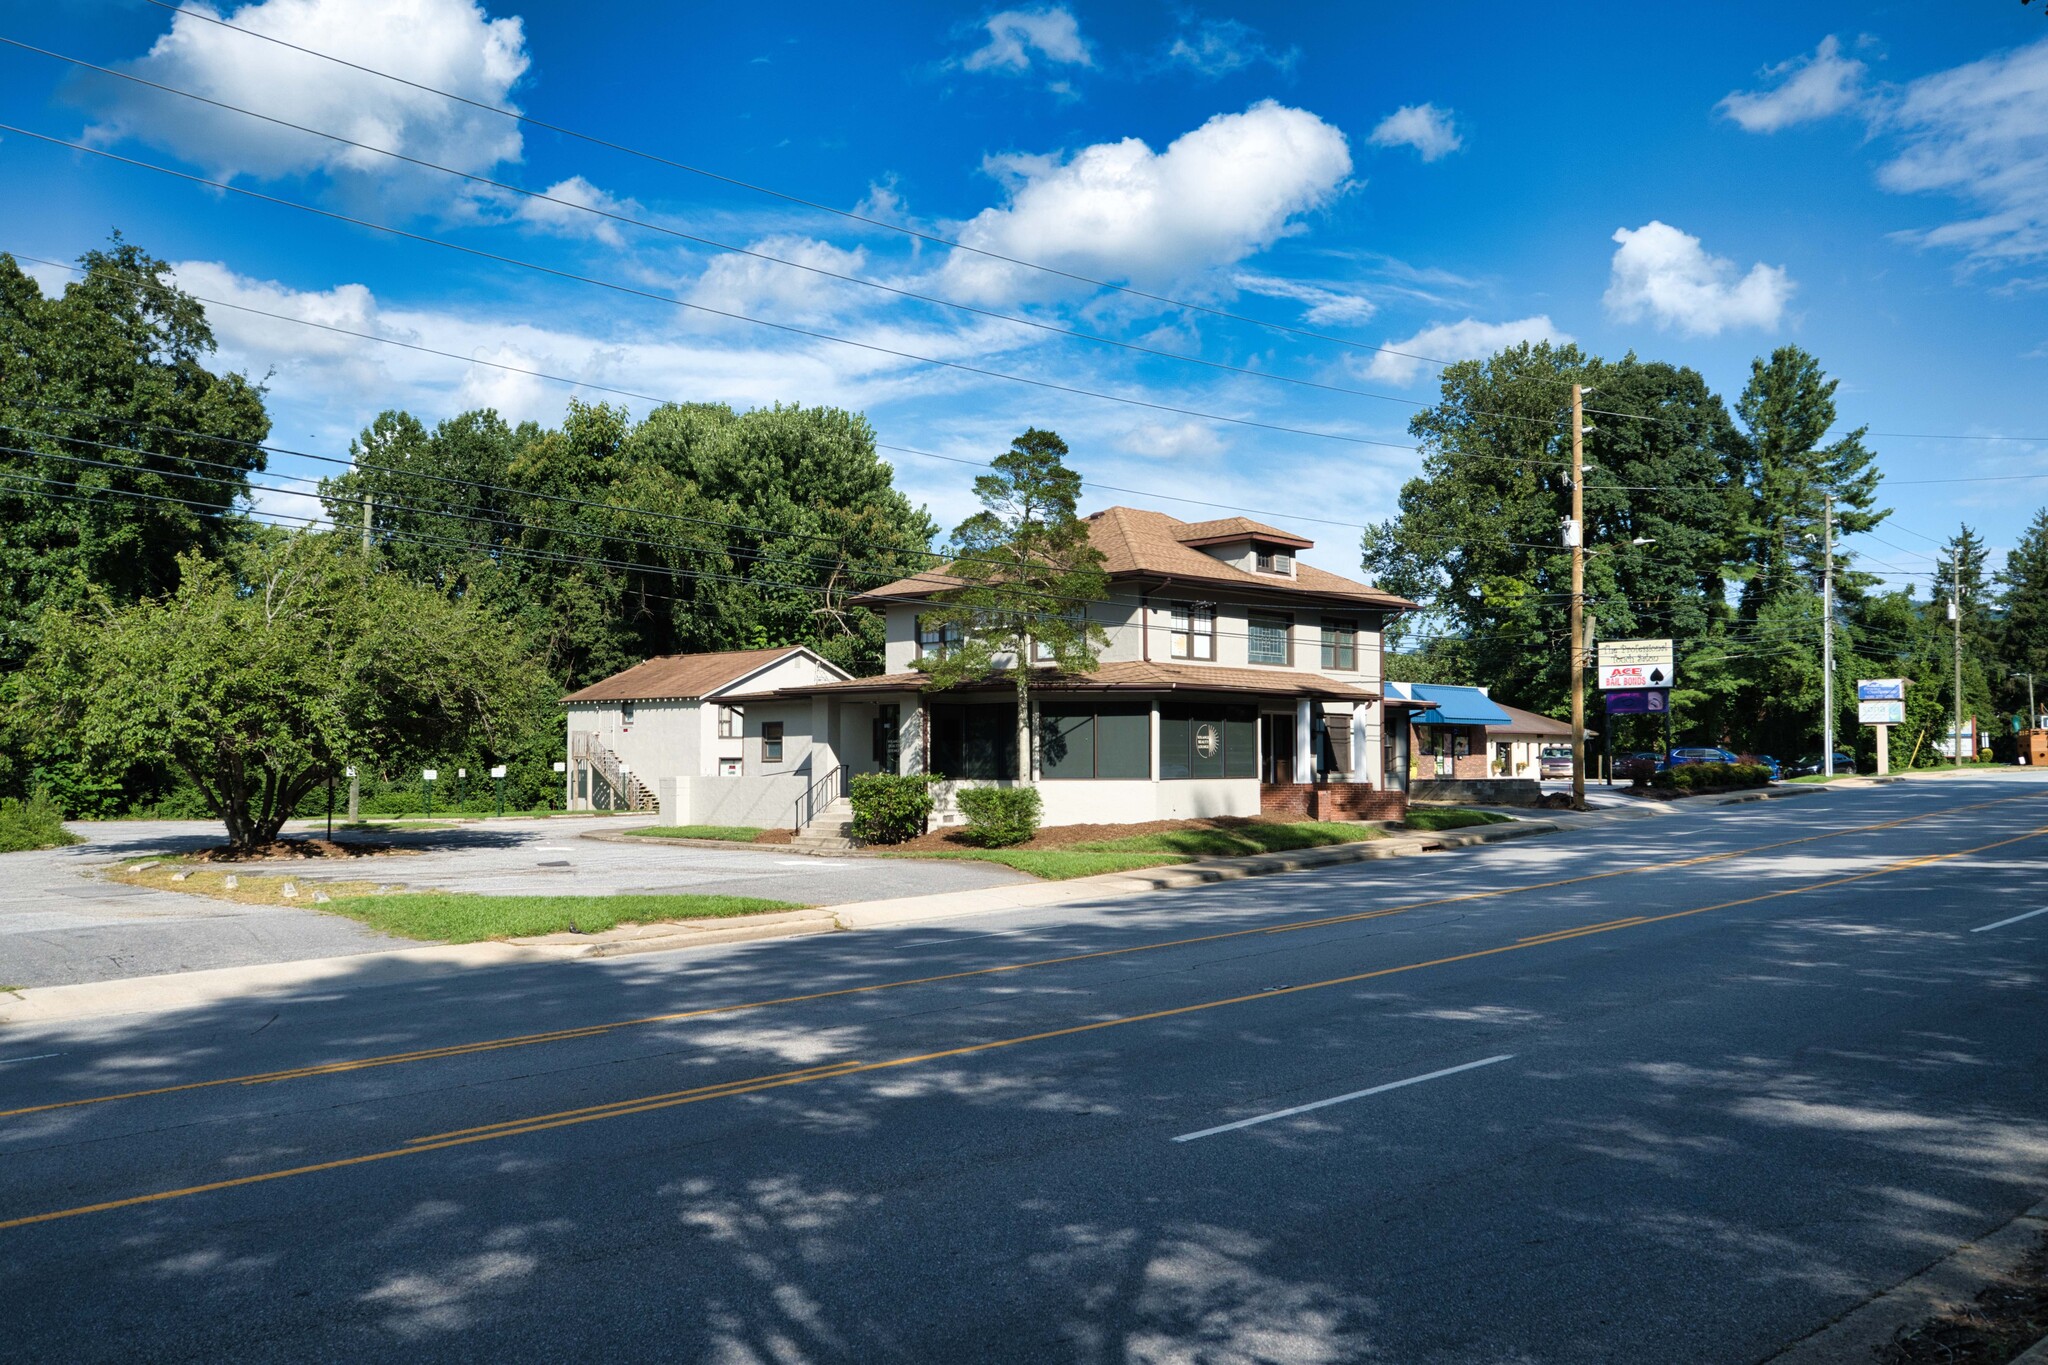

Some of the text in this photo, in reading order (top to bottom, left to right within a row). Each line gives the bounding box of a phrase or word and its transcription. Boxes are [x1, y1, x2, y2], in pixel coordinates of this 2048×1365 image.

[1611, 667, 1642, 676] ACE
[1606, 676, 1647, 686] BAIL BONDS
